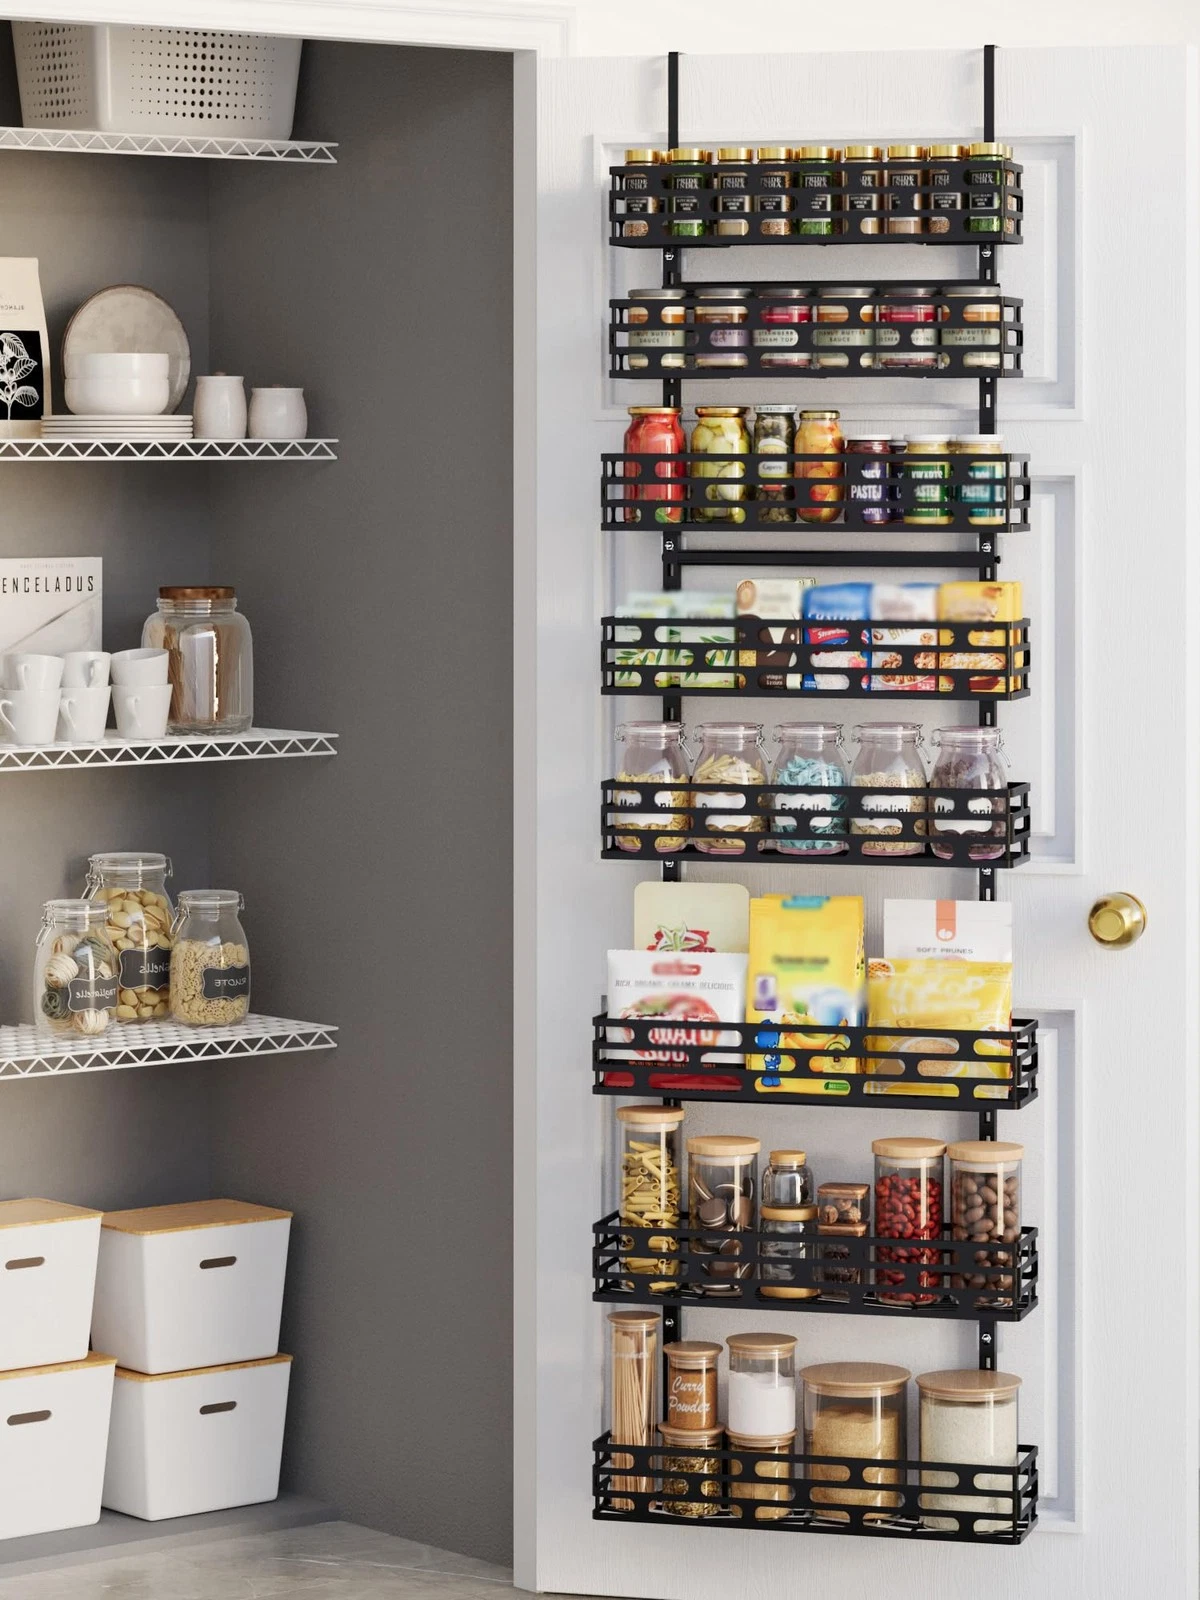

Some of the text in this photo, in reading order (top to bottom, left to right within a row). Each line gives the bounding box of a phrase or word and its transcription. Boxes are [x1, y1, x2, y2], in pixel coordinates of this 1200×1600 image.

[2, 575, 94, 593] ENCELADUS
[940, 946, 974, 954] PRUNES
[671, 1375, 705, 1397] Curry
[669, 1395, 711, 1413] Powder
